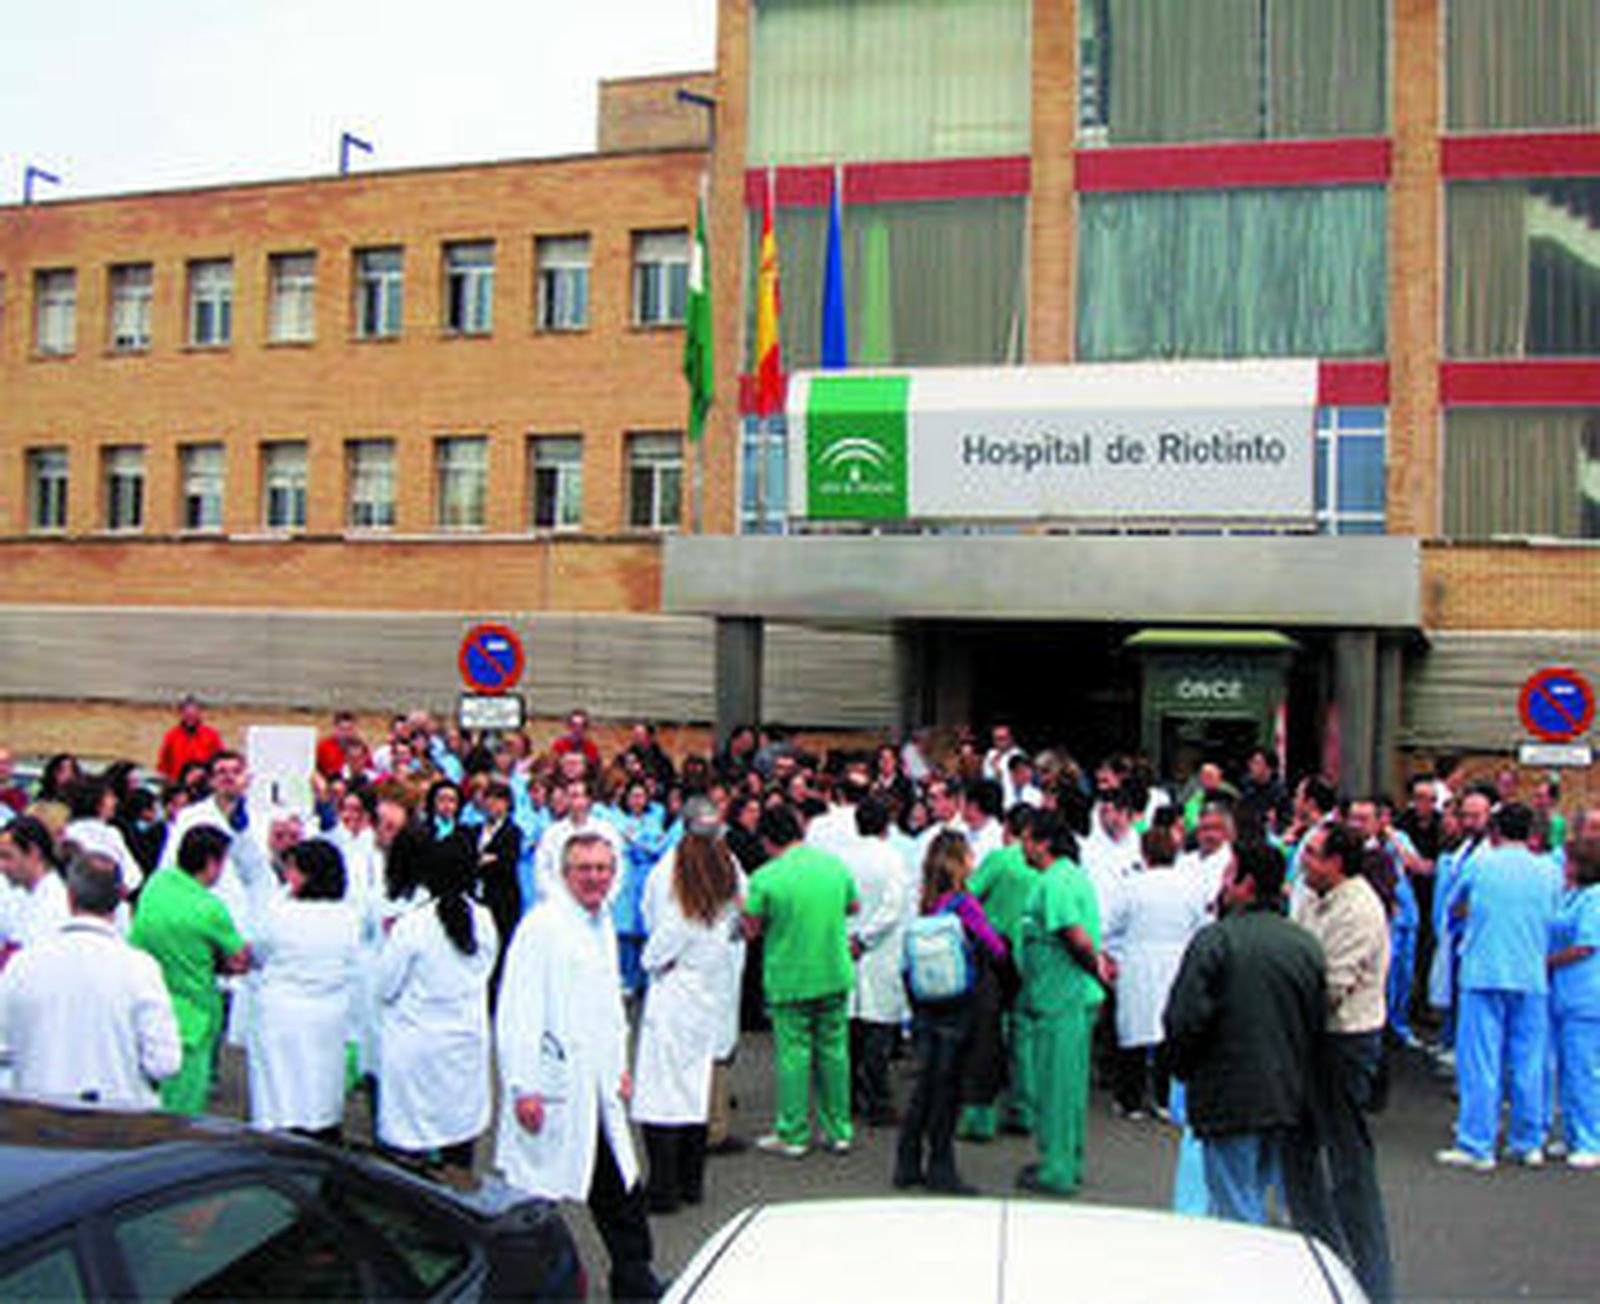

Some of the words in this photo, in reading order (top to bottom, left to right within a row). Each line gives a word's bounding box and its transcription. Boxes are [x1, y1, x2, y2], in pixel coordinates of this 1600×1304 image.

[963, 432, 1091, 472] Hospital
[1106, 434, 1145, 464] de
[1158, 431, 1286, 464] Riotinto
